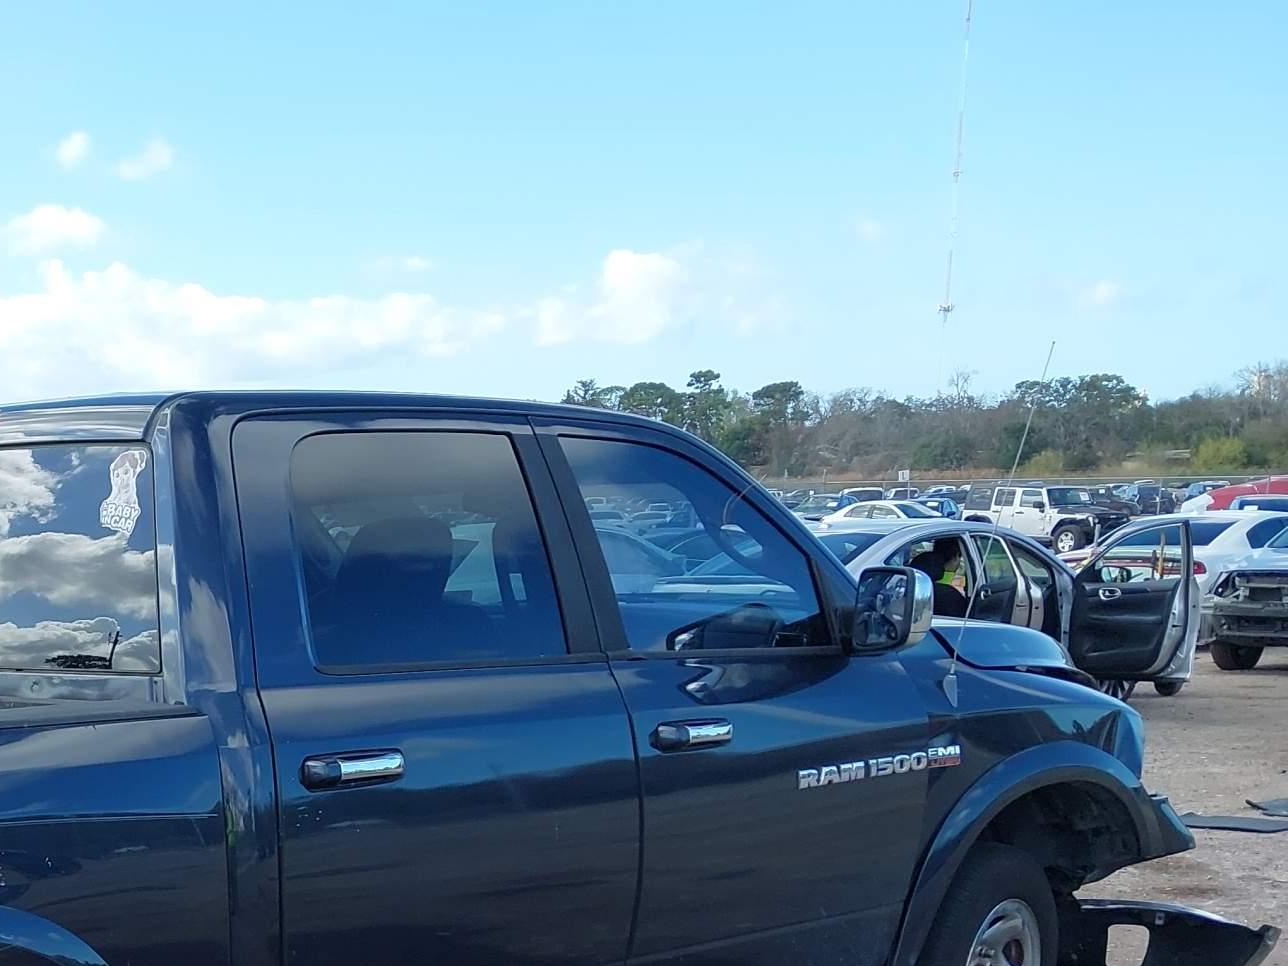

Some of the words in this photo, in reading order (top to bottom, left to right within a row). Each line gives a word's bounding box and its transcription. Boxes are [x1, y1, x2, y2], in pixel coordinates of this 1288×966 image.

[108, 503, 139, 520] BABY
[111, 516, 134, 533] CAR
[798, 761, 865, 790] RAM
[869, 752, 928, 777] 1500
